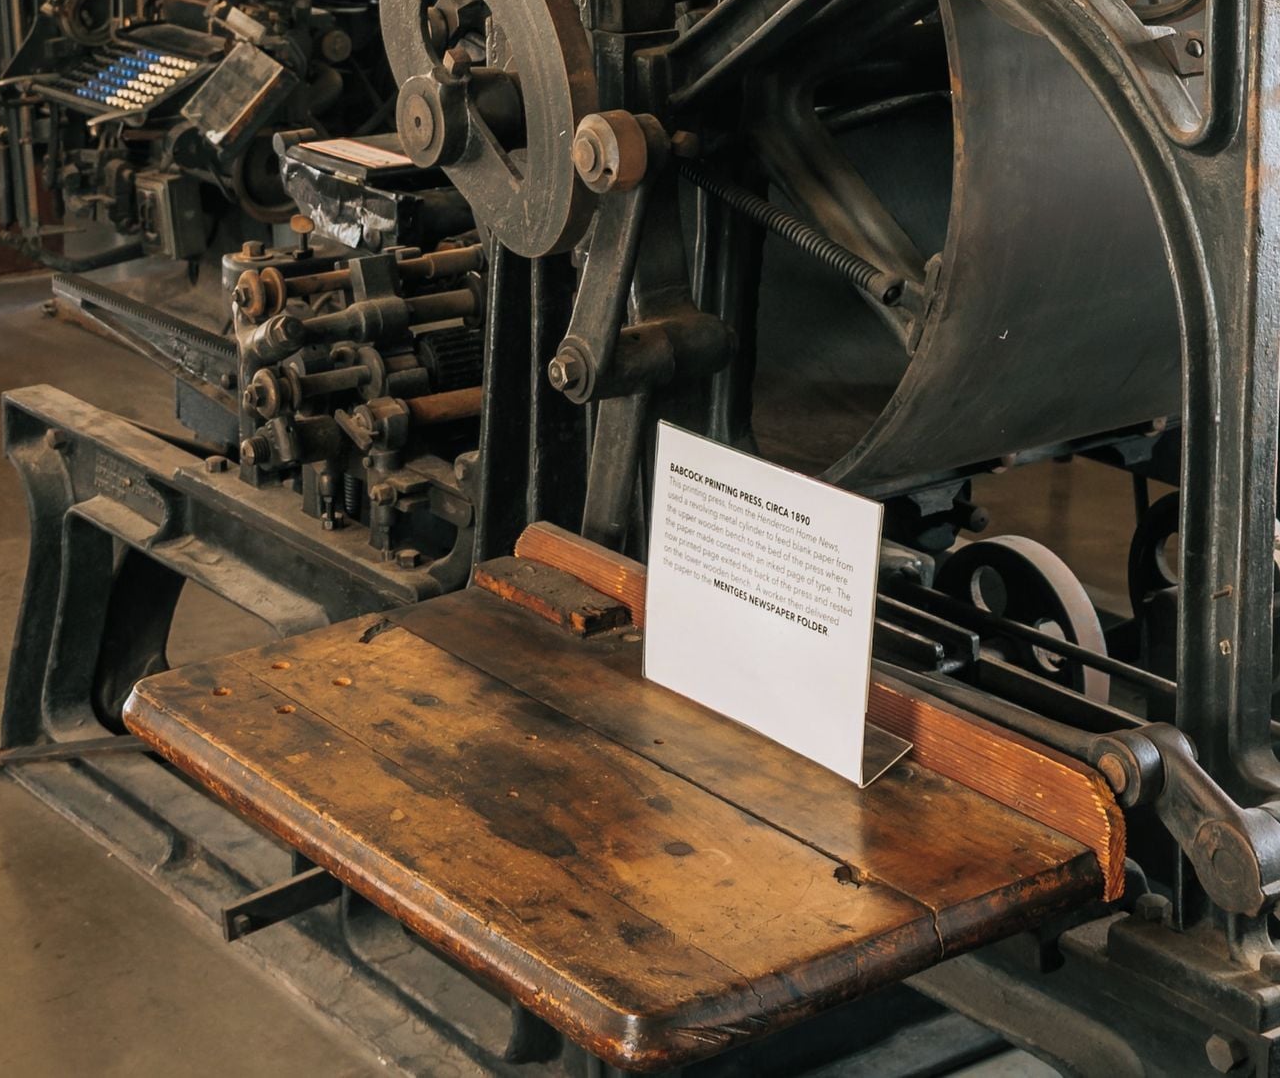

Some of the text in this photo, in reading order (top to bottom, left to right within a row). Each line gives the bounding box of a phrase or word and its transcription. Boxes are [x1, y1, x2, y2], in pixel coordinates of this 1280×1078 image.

[668, 492, 683, 503] used
[689, 500, 718, 519] revolving
[719, 513, 737, 526] metal
[738, 519, 764, 536] cylinder
[766, 532, 773, 541] to
[775, 534, 791, 547] feed
[793, 541, 811, 555] blank
[813, 550, 835, 565] paper
[836, 558, 854, 572] from
[669, 476, 681, 489] This
[682, 484, 707, 502] printing
[728, 501, 743, 514] from
[745, 508, 755, 520] the
[757, 512, 795, 535] Henderson
[796, 529, 817, 543] Home
[818, 537, 840, 554] News,
[670, 463, 811, 526] BABCOCK PRINTING PRESS, CIRCA 1890
[665, 517, 851, 602] the paper made contact with an inked page of type. The
[665, 532, 678, 542] now
[678, 538, 701, 553] printed
[702, 549, 719, 561] page
[742, 564, 753, 575] the
[754, 569, 769, 583] back
[771, 576, 779, 585] of
[780, 580, 791, 591] the
[793, 587, 812, 600] press
[814, 595, 827, 607] and
[829, 601, 853, 617] rested
[667, 504, 848, 586] the upper wooden bench to the bed of the press where
[663, 557, 673, 567] the
[674, 563, 693, 576] paper
[693, 570, 700, 580] to
[701, 574, 712, 585] the
[713, 578, 748, 602] MENTGES
[749, 594, 795, 622] NEWSPAPER
[664, 545, 672, 553] on
[673, 548, 683, 559] the
[684, 552, 702, 566] lower
[703, 562, 729, 578] wooden
[755, 584, 761, 593] A
[762, 588, 786, 602] worker
[788, 597, 803, 610] then
[805, 605, 839, 626] delivered
